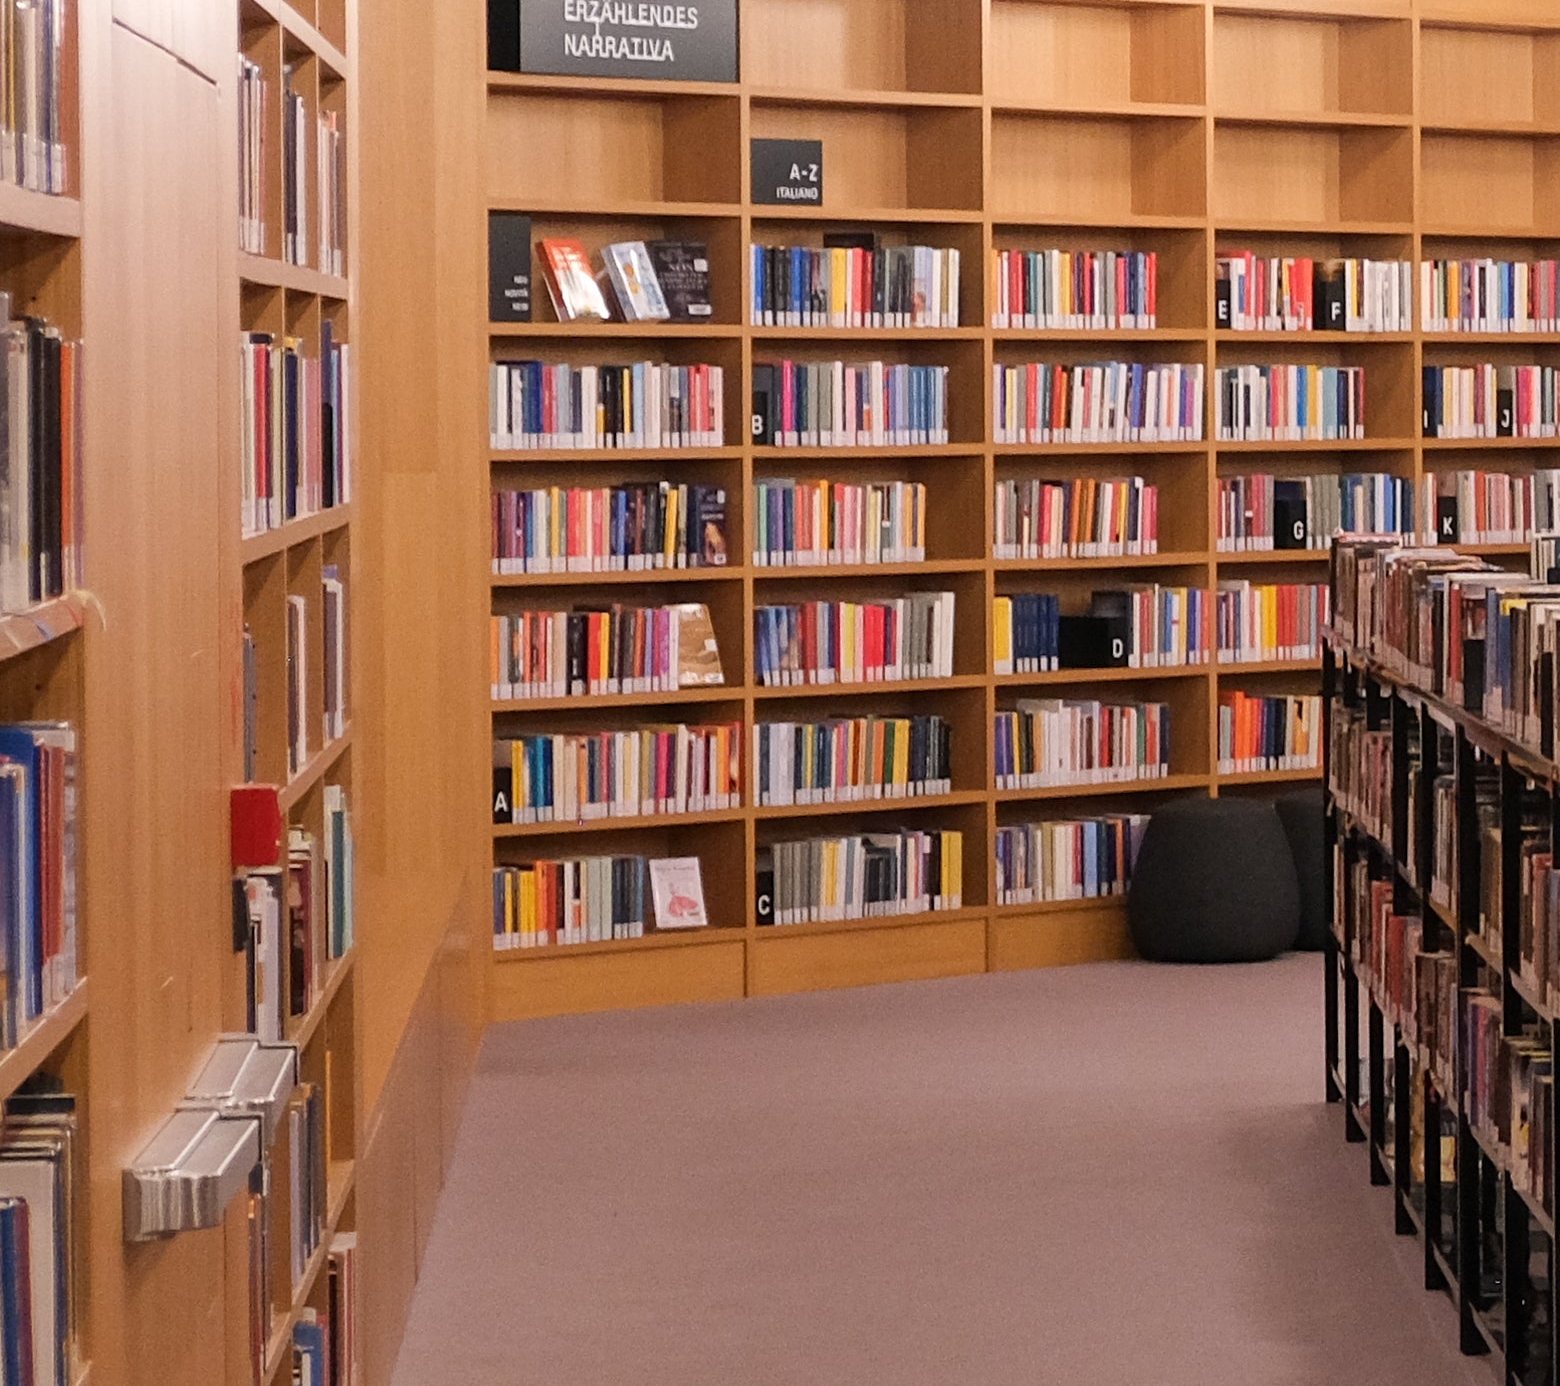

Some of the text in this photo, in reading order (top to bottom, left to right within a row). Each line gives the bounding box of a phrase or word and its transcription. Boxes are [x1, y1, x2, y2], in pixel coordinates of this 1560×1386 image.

[565, 34, 674, 62] NARRATIVA
[790, 163, 818, 181] A-Z
[776, 186, 818, 201] ITALIANO
[1218, 300, 1227, 319] E
[1331, 301, 1340, 321] F
[1501, 409, 1509, 428] J
[1294, 521, 1303, 540] G
[1442, 516, 1453, 535] K
[1112, 638, 1124, 659] D
[495, 791, 507, 813] A
[758, 894, 770, 917] C
